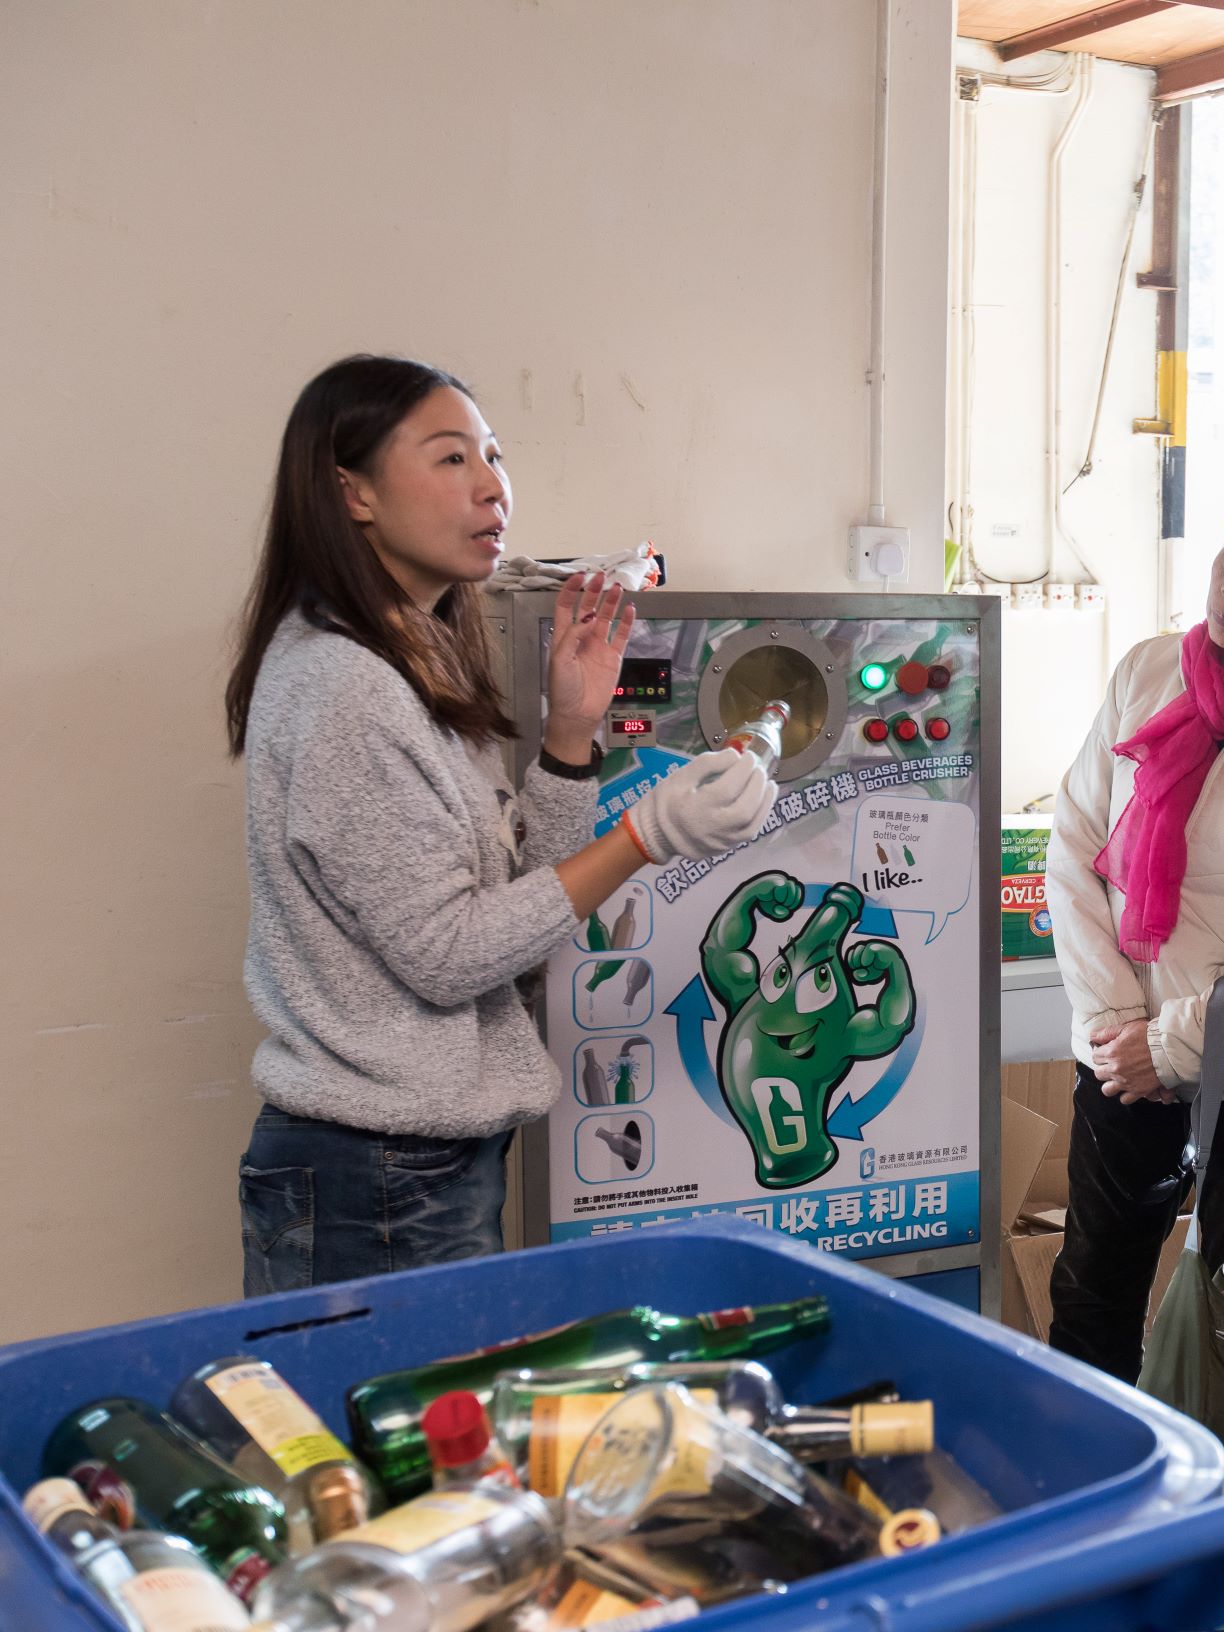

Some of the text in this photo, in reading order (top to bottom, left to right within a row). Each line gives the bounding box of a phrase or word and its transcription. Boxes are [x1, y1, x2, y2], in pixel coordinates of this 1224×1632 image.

[858, 755, 972, 781] GLASS BEVERAGES
[865, 766, 969, 791] BOTTLE CRUSHER
[656, 771, 858, 903] 飲品瓶破碎機
[873, 830, 921, 842] Bottle Color
[885, 822, 910, 832] Prefer
[862, 872, 869, 892] I
[879, 1145, 968, 1164] 香港玻璃資源有限公司
[817, 1221, 948, 1251] RECYCLING
